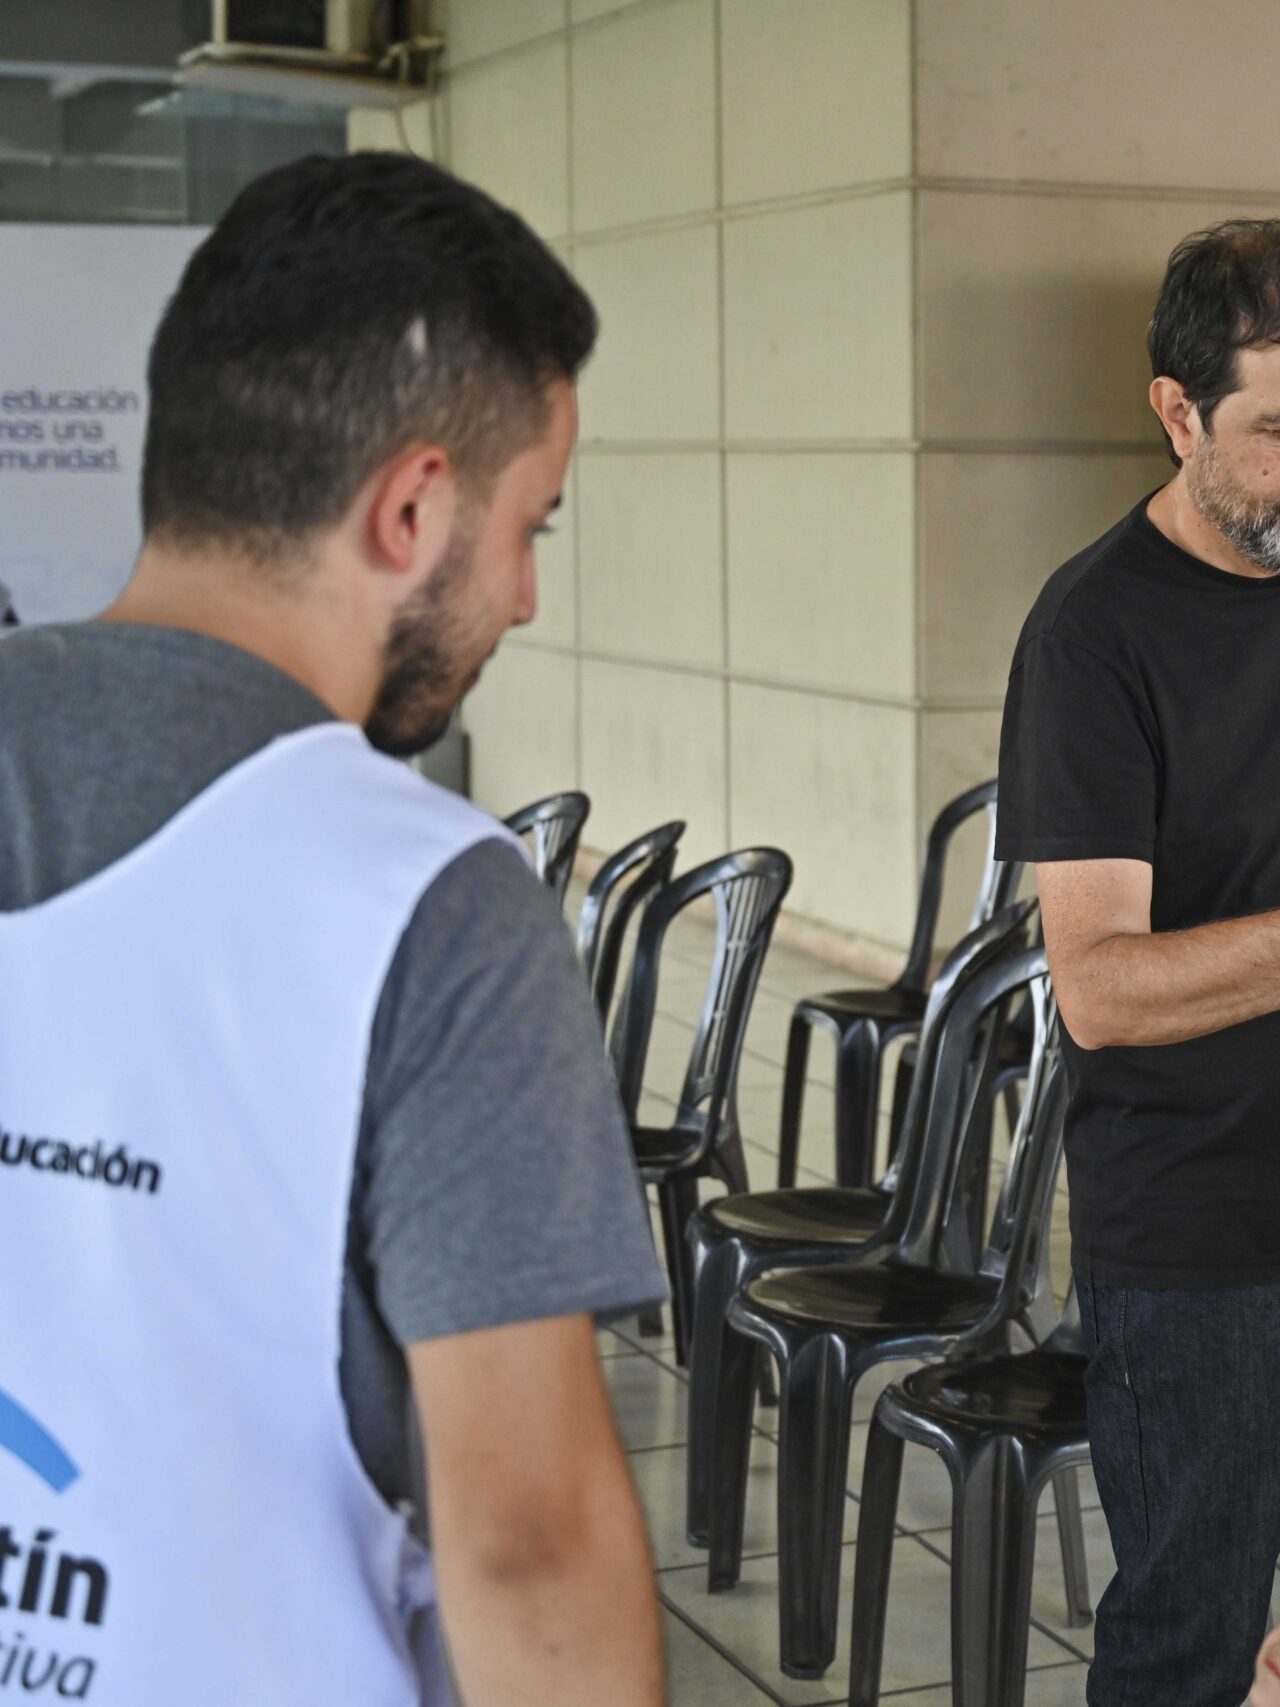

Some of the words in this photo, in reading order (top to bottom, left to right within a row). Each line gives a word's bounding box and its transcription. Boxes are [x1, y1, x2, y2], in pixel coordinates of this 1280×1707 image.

[1, 386, 140, 415] educación
[53, 420, 104, 445] una
[0, 1121, 161, 1194] ucación
[0, 1629, 96, 1700] iva
